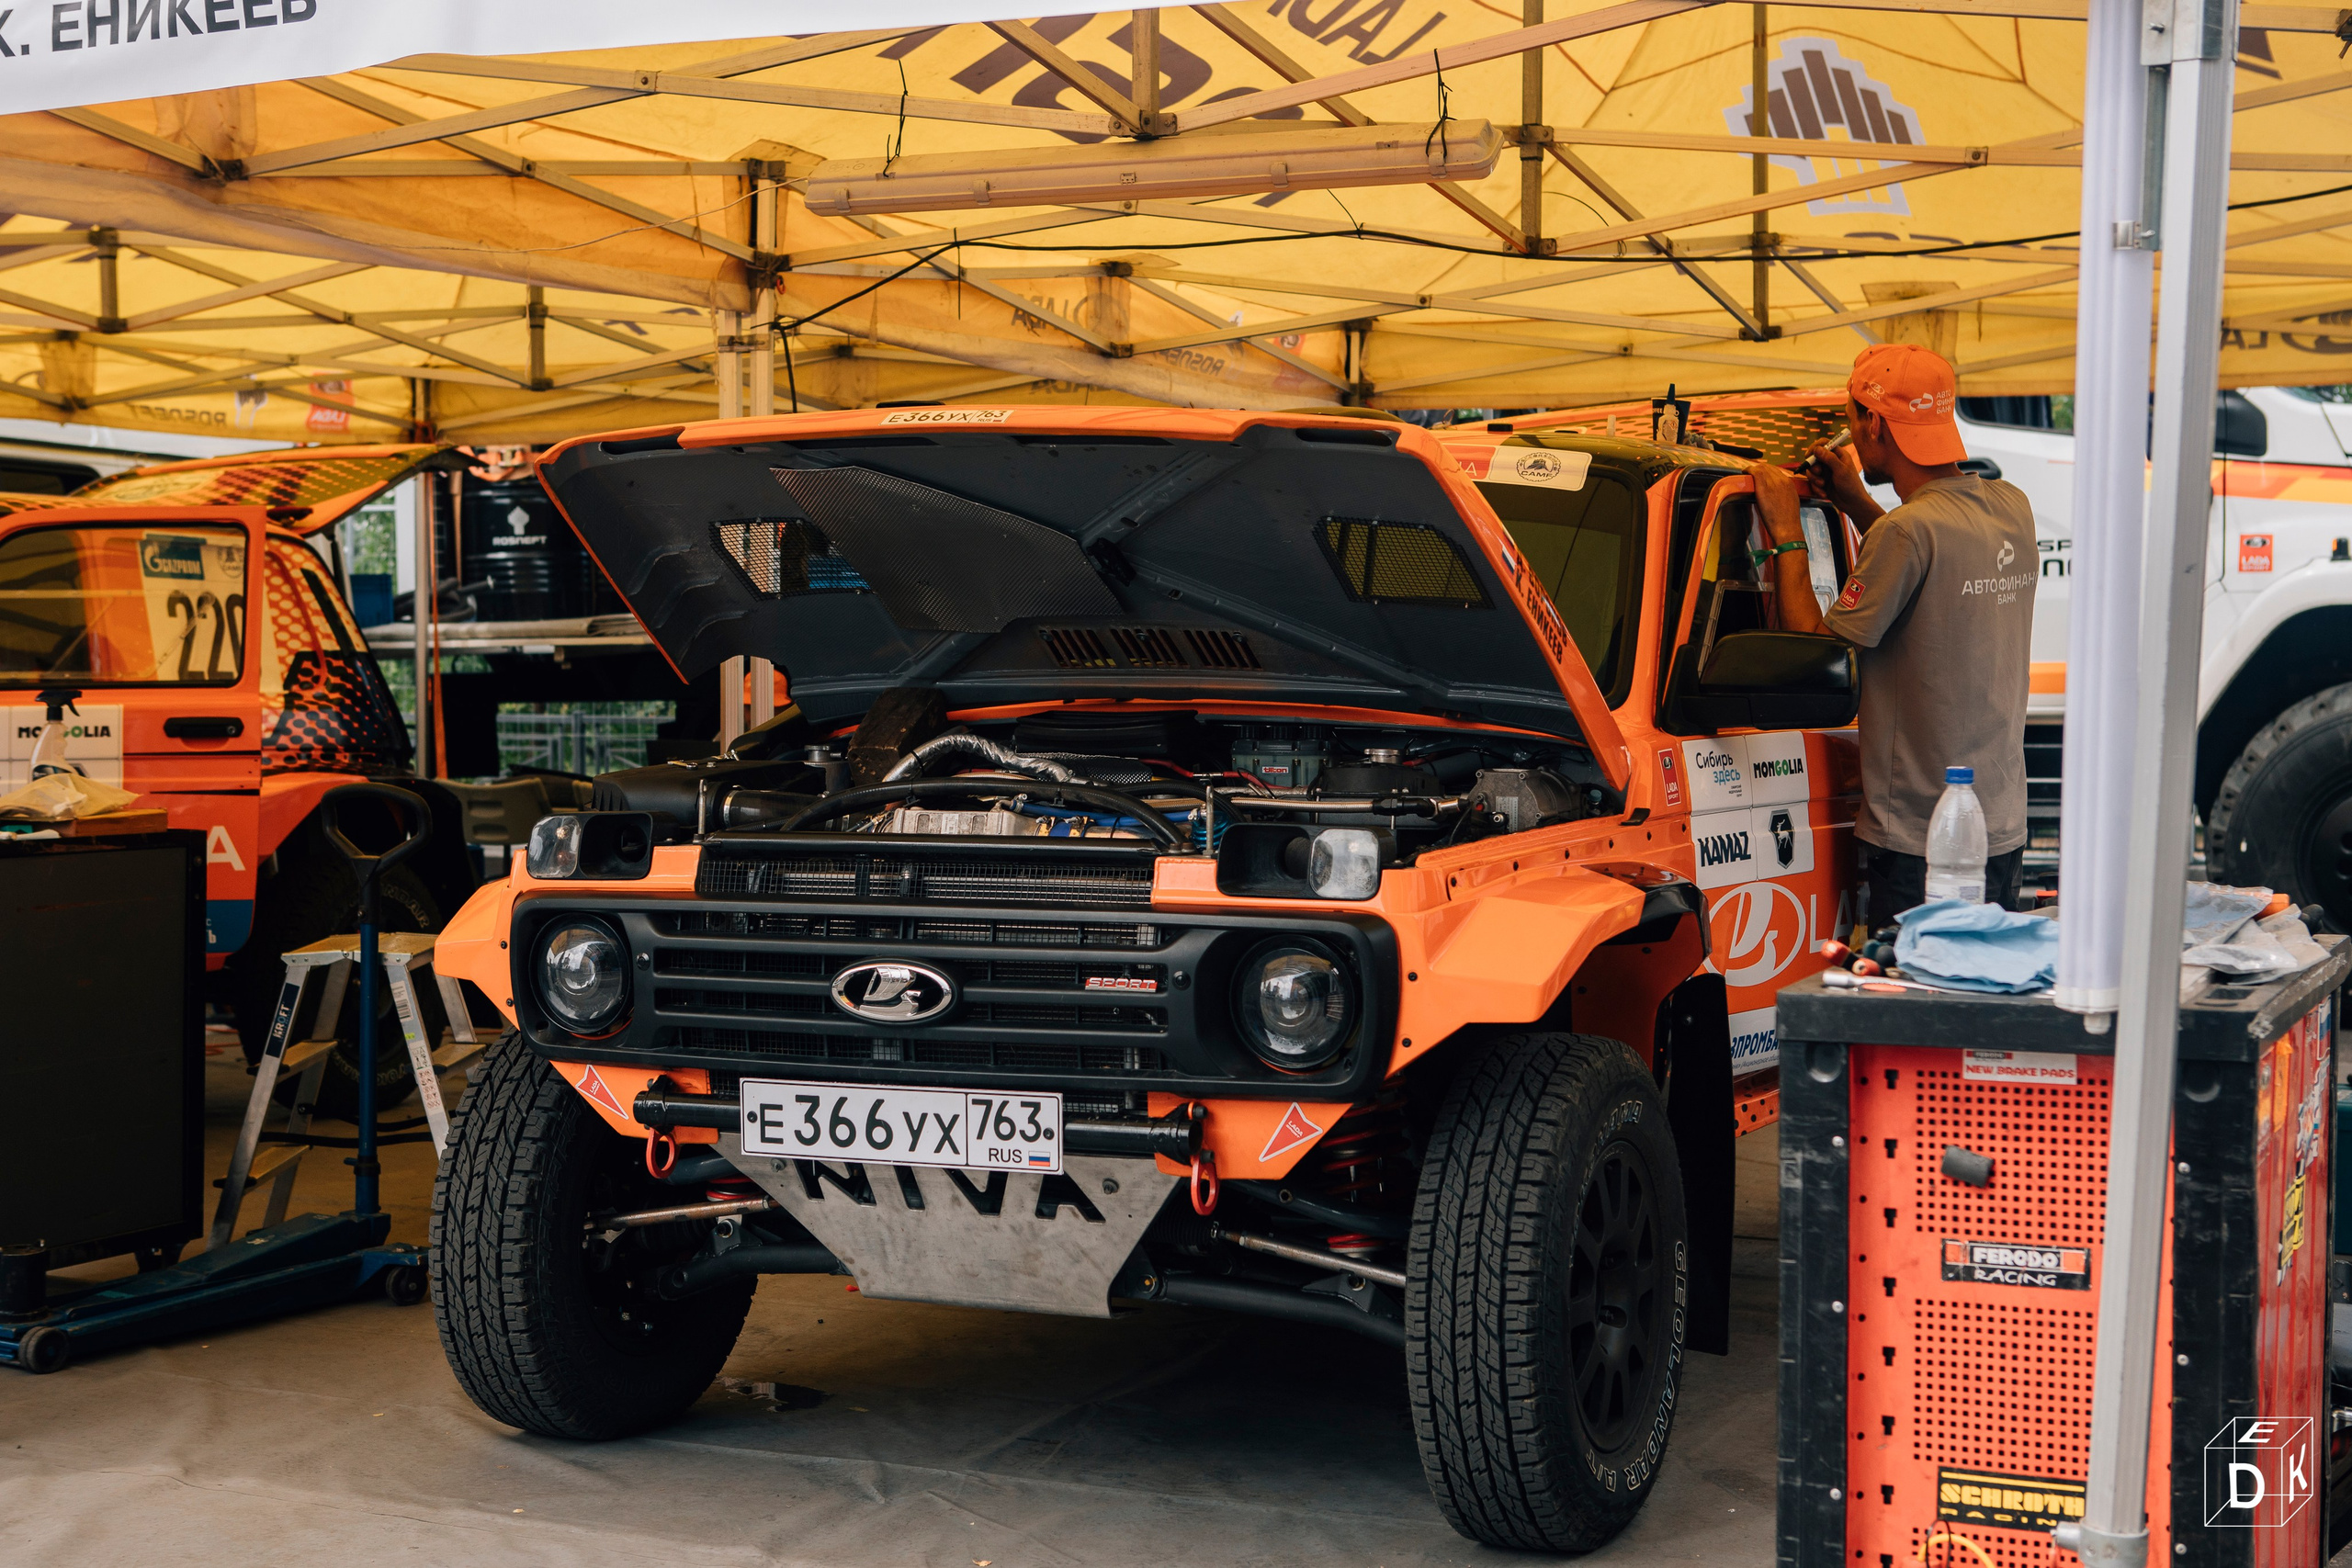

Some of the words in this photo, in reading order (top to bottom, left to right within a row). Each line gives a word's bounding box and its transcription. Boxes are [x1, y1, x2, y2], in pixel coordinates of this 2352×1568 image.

[492, 535, 548, 546] ROSNEFT
[1997, 592, 2017, 604] БАНК
[1695, 750, 1734, 771] Сибирь
[1753, 758, 1804, 779] MONGOLIA
[1713, 768, 1741, 786] здесь
[1666, 782, 1679, 794] LADA
[1697, 830, 1752, 867] KAMAZ
[1087, 976, 1157, 991] SPORT
[271, 1003, 290, 1039] KROFT
[1966, 1065, 1994, 1074] NEW
[1996, 1066, 2037, 1077] BRAKE
[2041, 1068, 2075, 1078] PADS
[971, 1099, 1042, 1143] 763
[1287, 1120, 1304, 1137] LADA
[988, 1148, 1023, 1163] RUS
[1973, 1247, 2059, 1269] FERODO
[1973, 1268, 2058, 1287] RACING
[1627, 1239, 1688, 1492] GEOLANDAR
[1584, 1449, 1618, 1494] A/T
[1939, 1483, 2086, 1517] SCHROTH
[1939, 1506, 2058, 1527] RACIN
